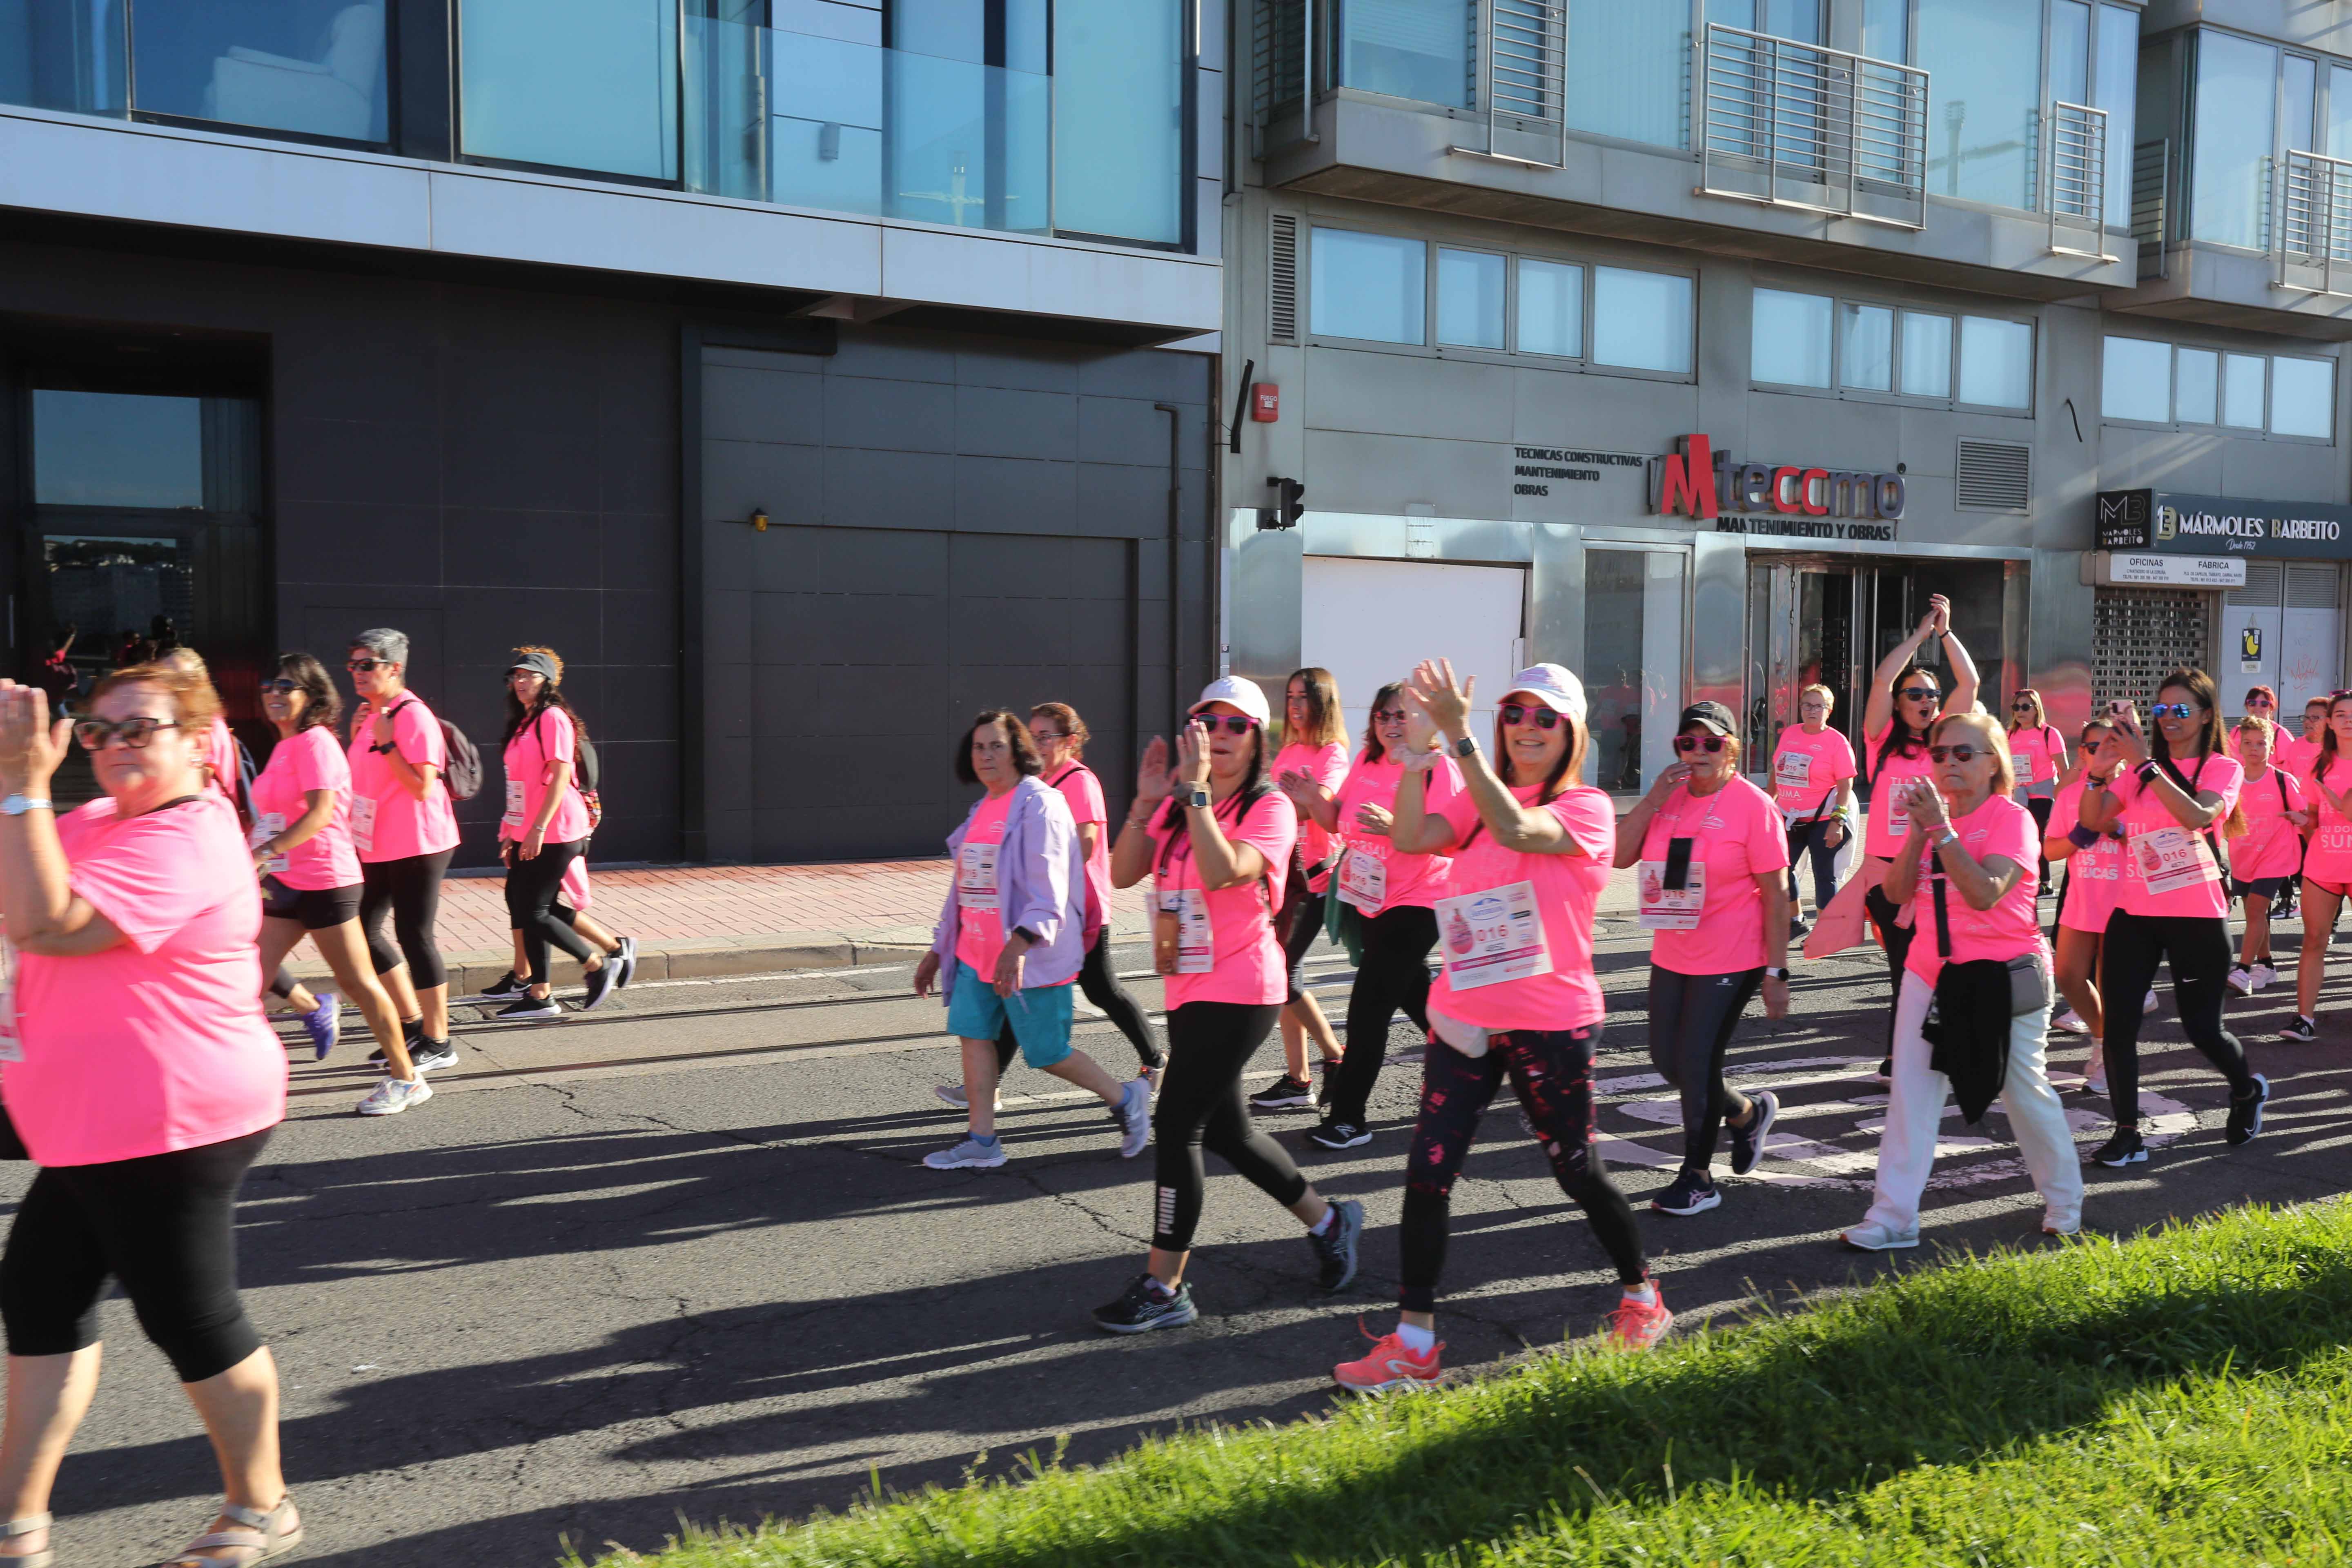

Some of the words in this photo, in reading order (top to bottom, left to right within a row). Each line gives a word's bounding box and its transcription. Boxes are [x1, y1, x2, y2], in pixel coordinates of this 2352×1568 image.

[1515, 447, 1563, 461] TECNICAS
[1564, 451, 1643, 467] CONSTRUCTIVAS
[1515, 466, 1600, 481] MANTENIMIENTO
[1514, 484, 1548, 496] OBRAS
[1836, 523, 1846, 539] Y
[1848, 523, 1891, 541] OBRAS
[2179, 510, 2264, 537] MÁRMOLES
[2271, 519, 2340, 541] BARBEITO
[2103, 535, 2143, 546] BARBEITO
[2130, 558, 2163, 567] OFICINAS
[2163, 849, 2187, 862] 016
[1475, 924, 1509, 942] 016
